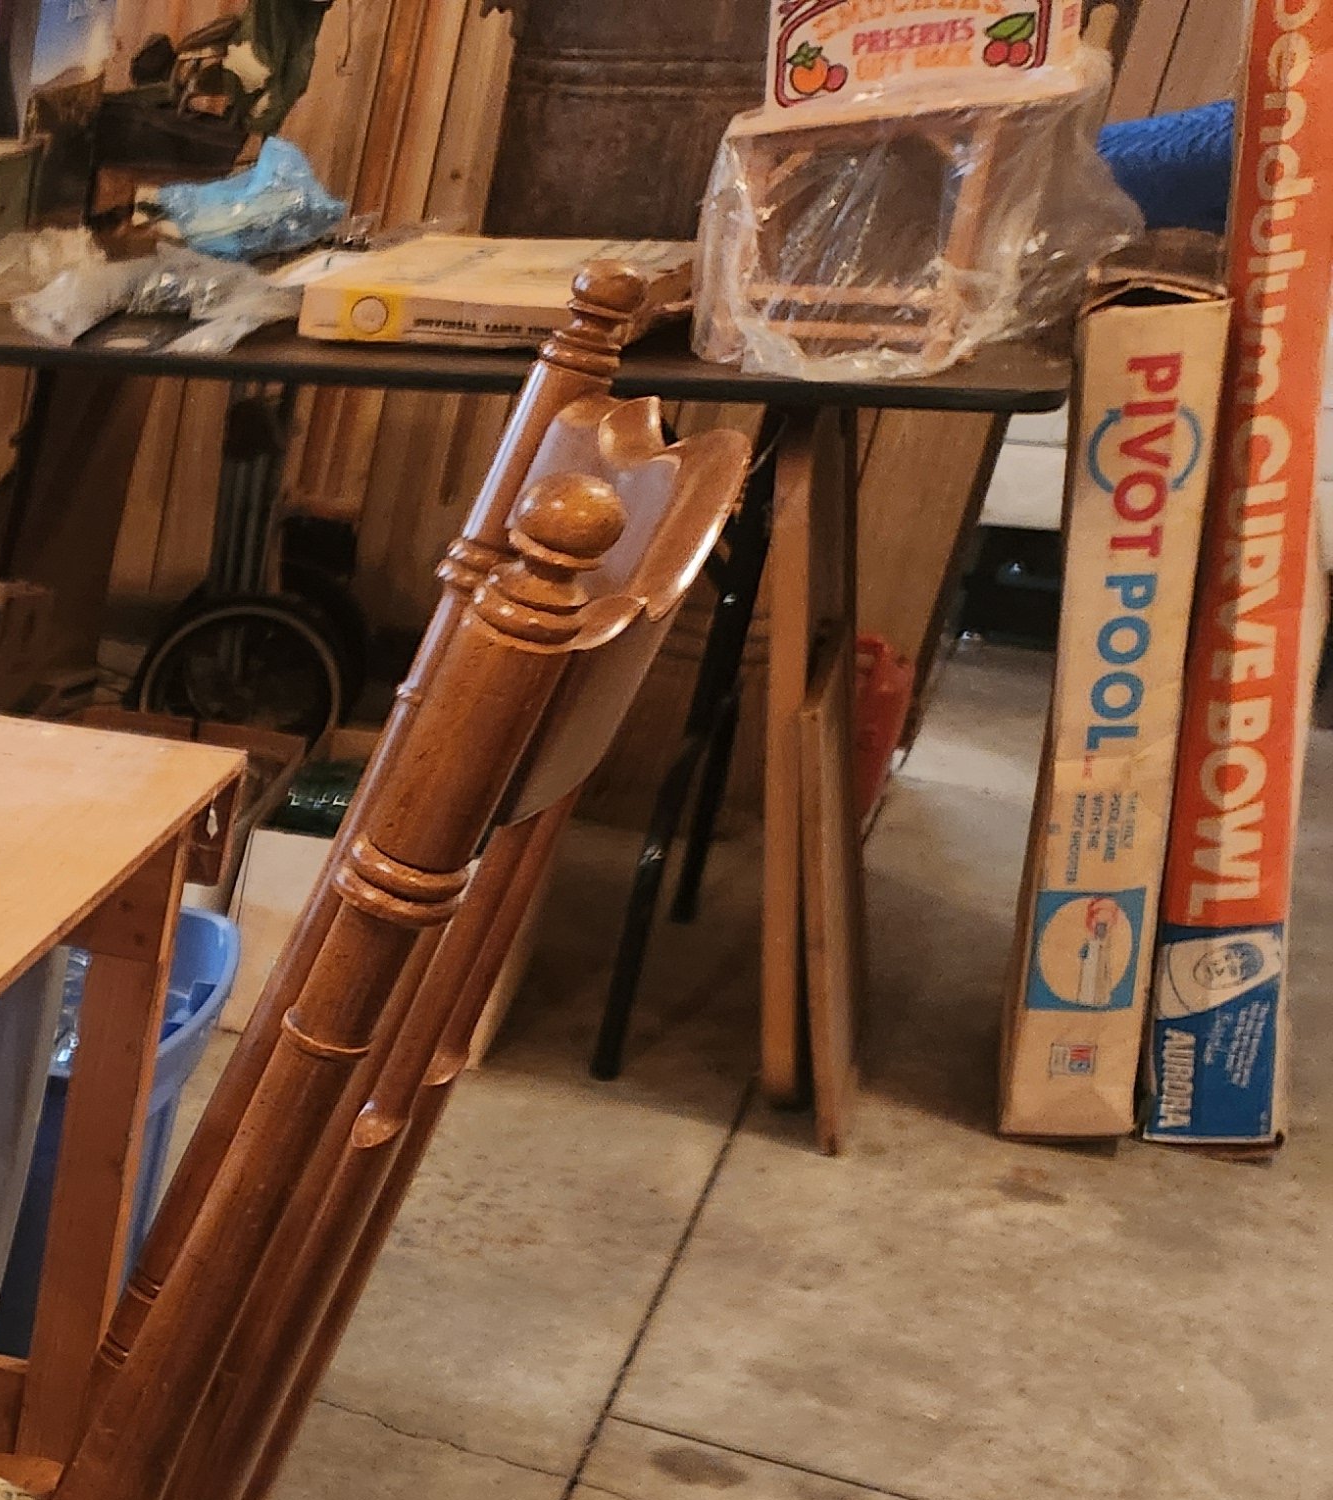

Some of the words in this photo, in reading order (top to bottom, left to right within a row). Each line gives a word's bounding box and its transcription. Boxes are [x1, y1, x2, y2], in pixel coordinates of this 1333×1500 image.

[852, 17, 975, 55] PRESERVES
[1109, 352, 1184, 559] PIVOT
[1209, 414, 1293, 682] CURVE
[1085, 573, 1158, 752] POOL
[1185, 696, 1272, 918] BOWL
[1157, 1028, 1197, 1129] AURORA
